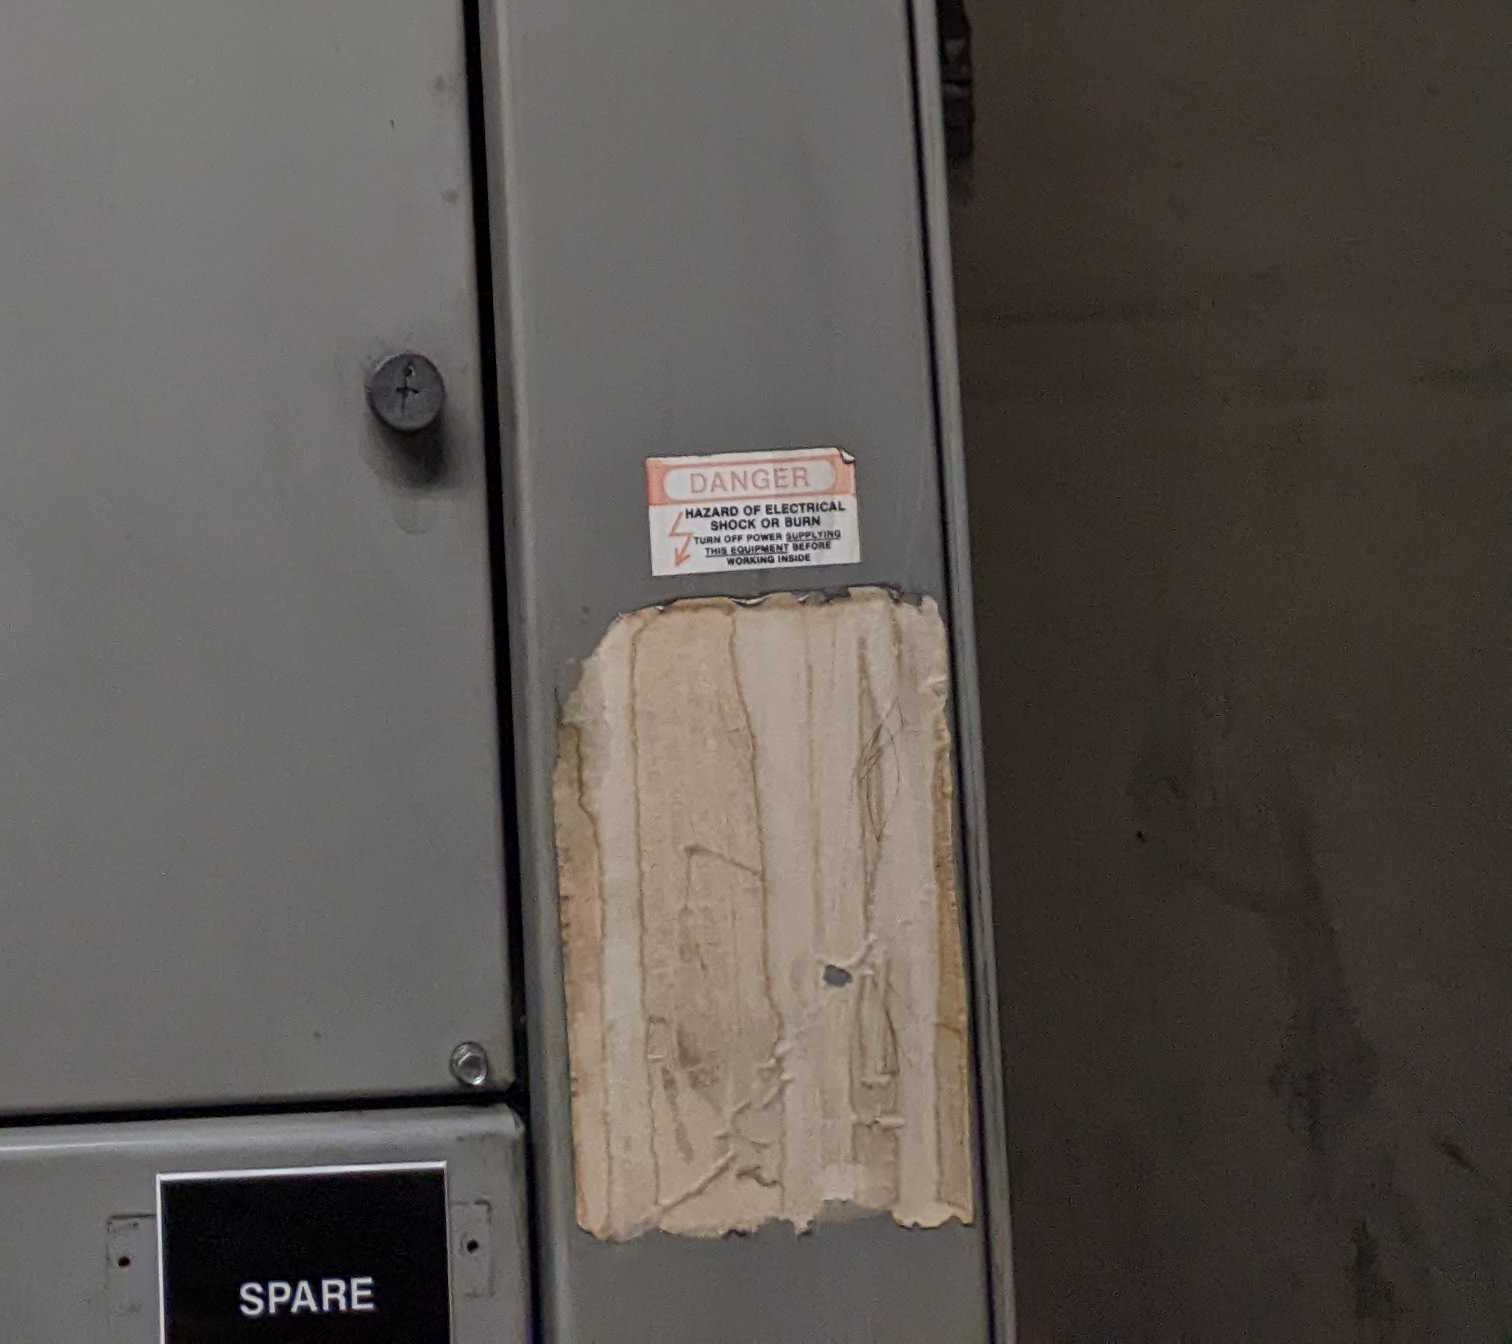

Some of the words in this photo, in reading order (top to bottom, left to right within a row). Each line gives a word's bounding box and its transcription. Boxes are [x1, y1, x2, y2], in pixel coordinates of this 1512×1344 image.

[689, 466, 811, 494] DANGER
[685, 505, 739, 519] HAZARD
[743, 504, 761, 517] OF
[765, 501, 846, 516] ELECTRICAL
[710, 518, 756, 531] SHOCK
[760, 517, 780, 529] OR
[785, 515, 821, 528] BURN
[694, 534, 721, 545] TURN
[724, 533, 744, 544] OFF
[746, 532, 783, 543] POWER
[786, 529, 842, 541] SUPPLYING
[705, 547, 727, 557] THIS
[731, 544, 788, 556] EQUIPMENT
[792, 540, 832, 551] BEFORE
[726, 555, 775, 566] WORKING
[778, 553, 811, 563] INSIDE
[238, 1276, 375, 1316] SPARE
